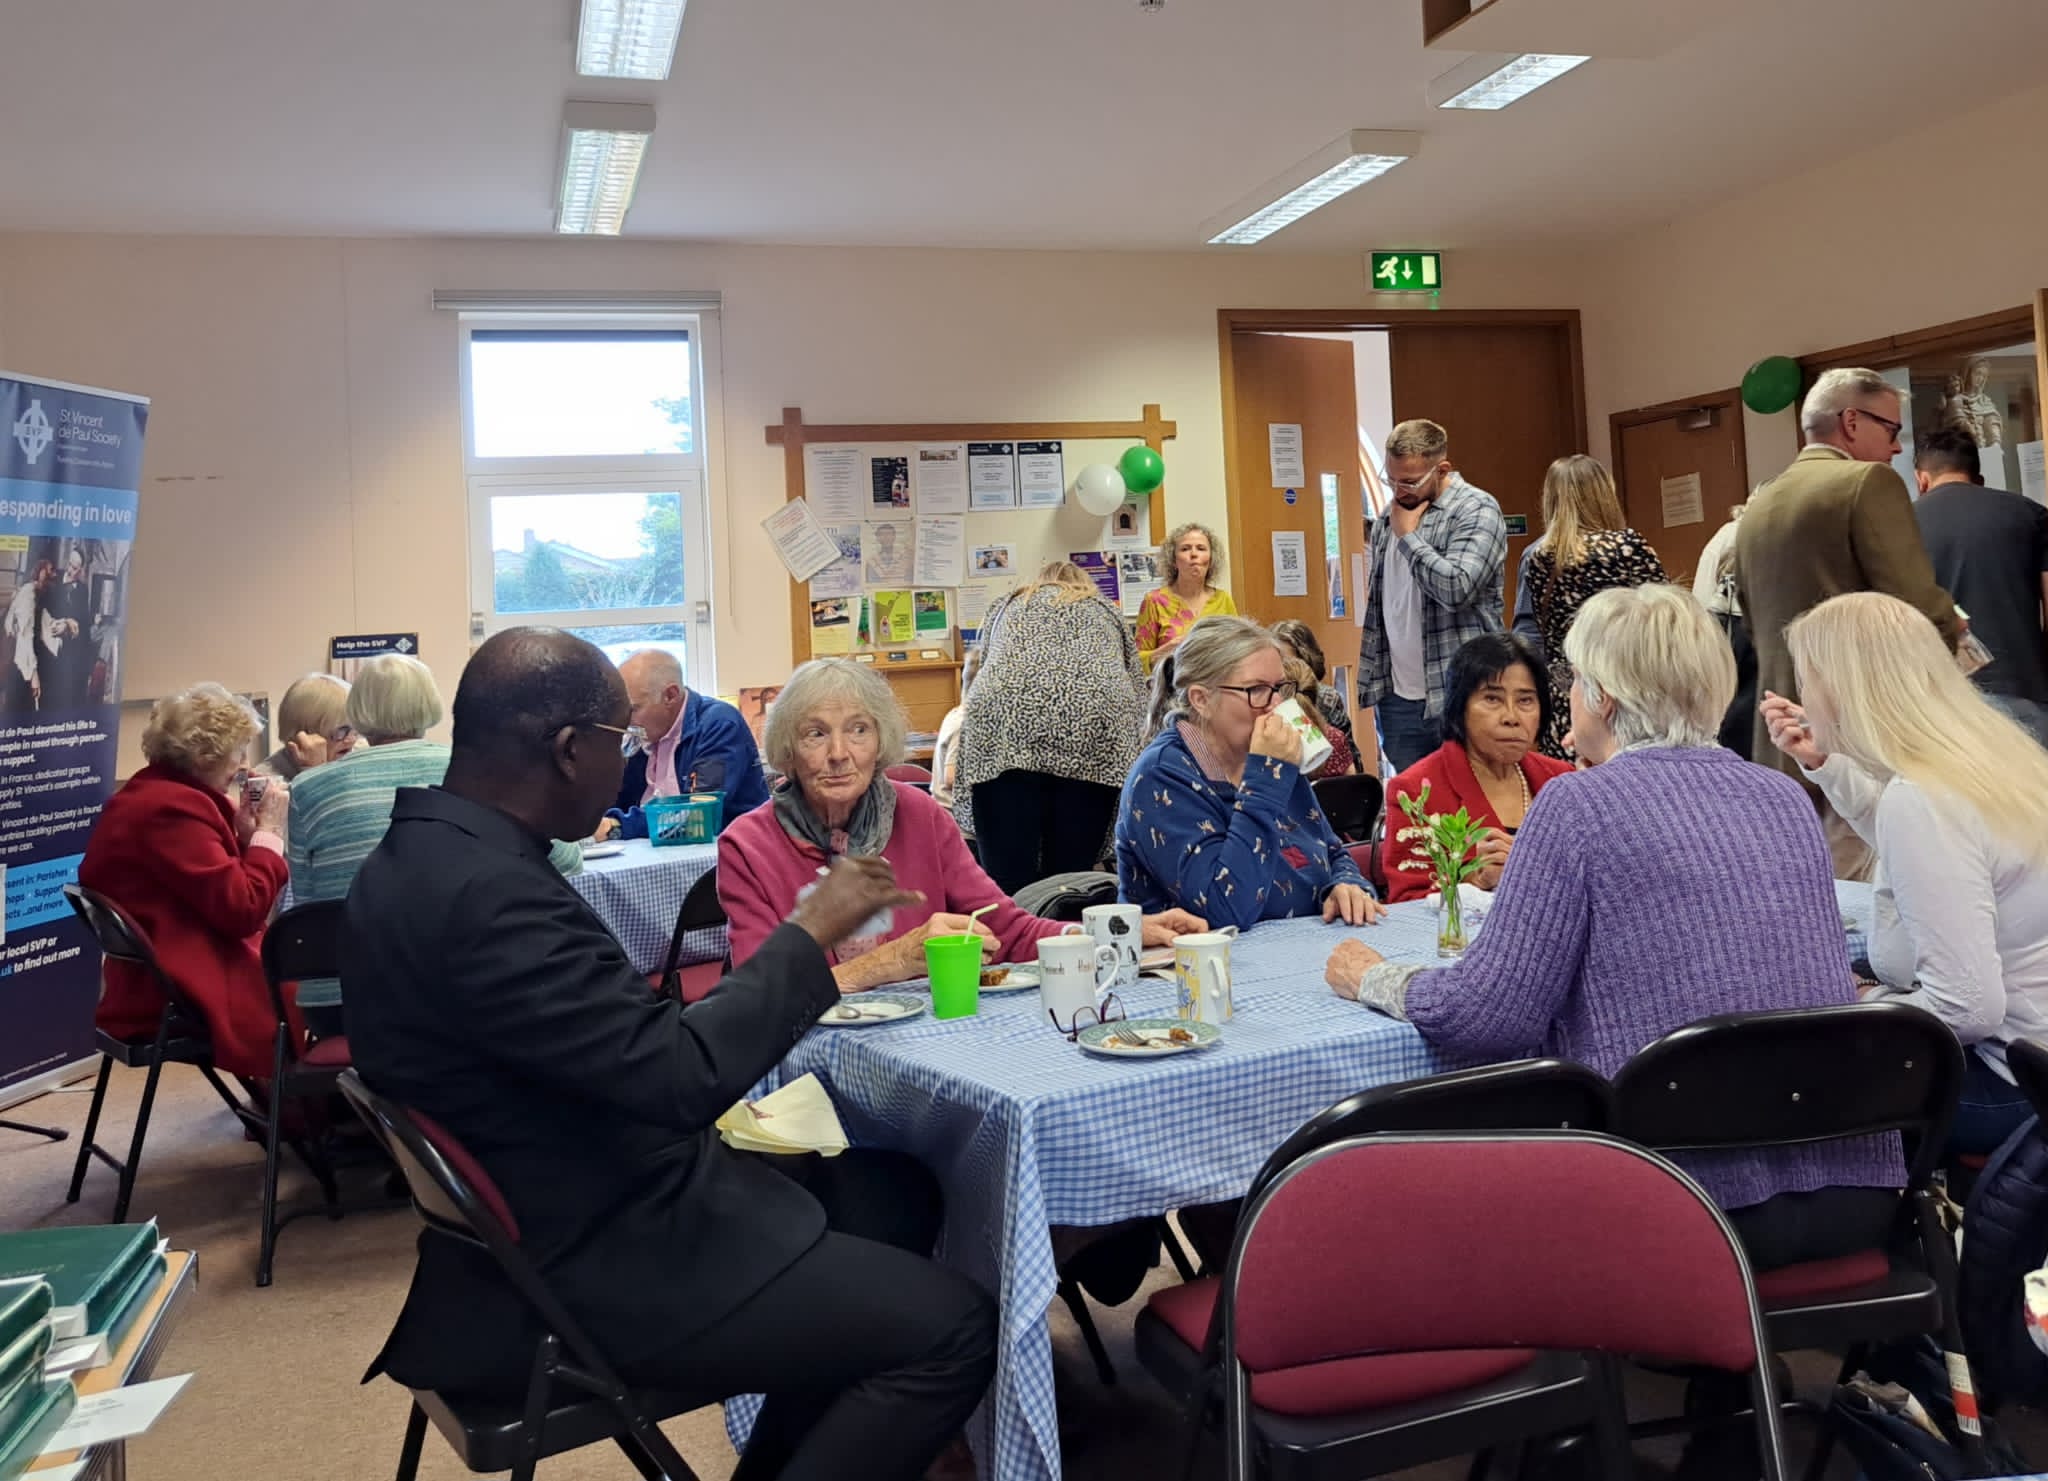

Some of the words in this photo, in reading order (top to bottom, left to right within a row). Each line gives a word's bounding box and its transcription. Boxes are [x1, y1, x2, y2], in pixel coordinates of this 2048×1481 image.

[60, 408, 70, 423] St
[71, 411, 103, 427] Vincent
[58, 427, 71, 438] de
[72, 428, 91, 442] Paul
[92, 429, 121, 448] Society
[85, 501, 99, 521] in
[102, 504, 131, 523] love
[336, 641, 355, 650] Help
[357, 640, 370, 648] the
[372, 639, 387, 647] SVP
[30, 938, 47, 952] SVP
